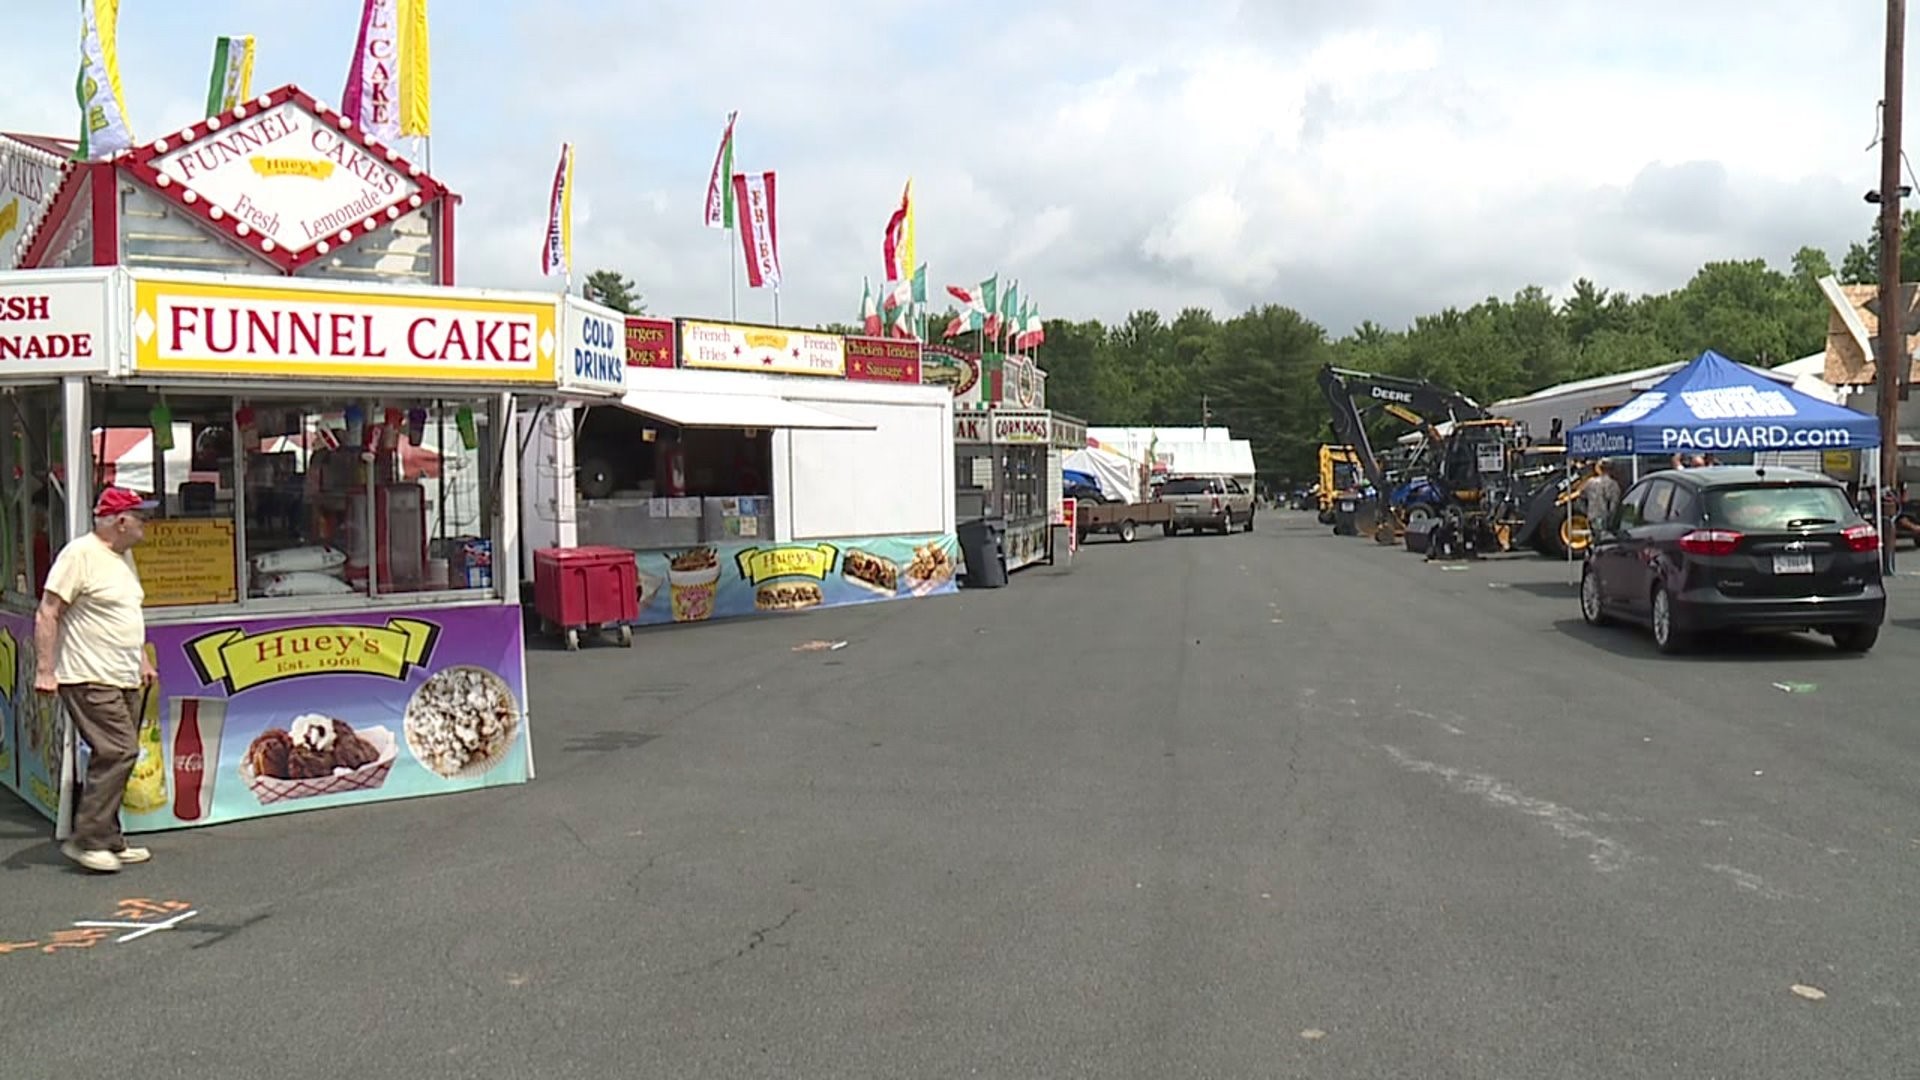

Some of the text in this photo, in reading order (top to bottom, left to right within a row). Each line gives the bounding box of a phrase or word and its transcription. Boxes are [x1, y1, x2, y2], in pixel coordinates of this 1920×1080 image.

[368, 38, 392, 124] CAKE
[175, 111, 399, 196] FUNNEL CAKES
[266, 158, 320, 174] Huey's
[8, 154, 44, 204] CAKES
[233, 188, 382, 241] Fresh Lemonade
[752, 189, 772, 274] FRIES
[170, 305, 532, 362] FUNNEL CAKE
[582, 316, 615, 350] COLD
[692, 326, 731, 342] French
[803, 335, 838, 352] French
[847, 342, 884, 356] Chicken
[699, 346, 728, 361] Fries
[809, 354, 834, 369] Fries
[574, 347, 622, 383] DRINKS
[865, 362, 904, 379] Sausage
[1371, 386, 1413, 403] DEERE
[995, 420, 1021, 439] CORN
[1022, 420, 1048, 439] DOGS
[1662, 425, 1850, 449] PAGUARD.com
[152, 524, 200, 538] Try our
[762, 551, 816, 569] Huey's
[255, 630, 381, 663] Huey's
[276, 656, 362, 673] Est. 1968
